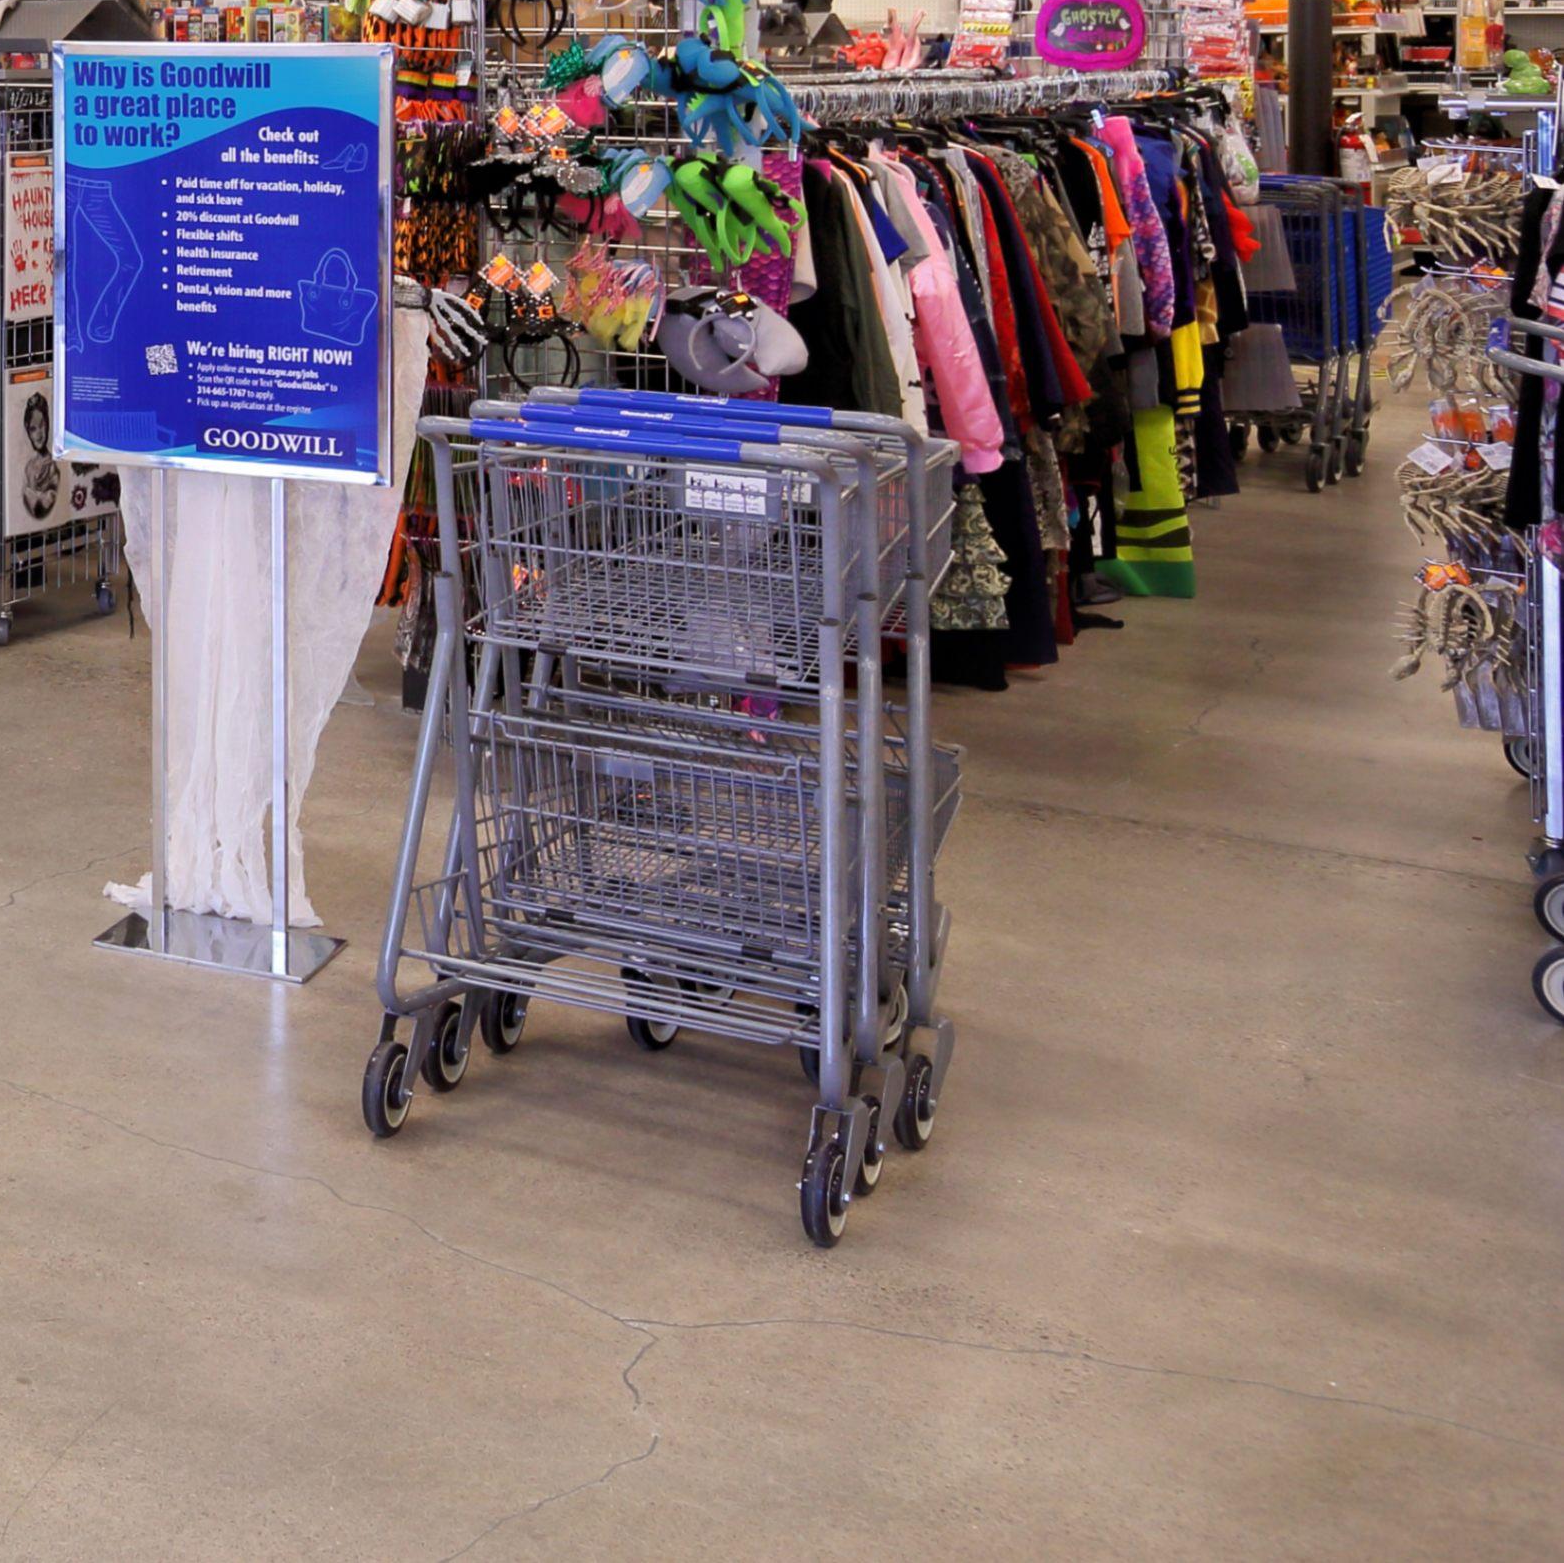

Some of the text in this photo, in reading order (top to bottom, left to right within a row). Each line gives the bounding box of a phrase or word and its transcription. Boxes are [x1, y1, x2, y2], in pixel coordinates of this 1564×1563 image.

[1060, 7, 1122, 26] GHOSTLY
[73, 61, 271, 89] Why is Goodwill
[74, 93, 237, 120] a great place
[74, 122, 181, 147] to work?
[258, 126, 319, 143] Check out
[221, 147, 319, 165] all the benefits:
[176, 176, 345, 196] Paid time off for vacation, holiday,
[12, 186, 53, 211] HAUNT
[176, 192, 243, 206] and sick leave
[176, 210, 299, 226] 20% discount at Goodwill
[176, 228, 244, 242] Flexible shifts
[176, 246, 259, 261] Health insurance
[176, 264, 233, 278] Retirement
[176, 282, 292, 299] Dental, vision and more
[176, 299, 217, 313] benefits
[186, 340, 353, 366] We're hiring RIGHT NOW!
[197, 362, 216, 374] Apply
[216, 364, 236, 374] online
[197, 374, 212, 383] Scan
[213, 375, 224, 384] the
[224, 376, 234, 385] QR
[235, 377, 250, 386] code
[330, 384, 338, 392] to
[197, 397, 210, 407] Pick
[211, 400, 220, 409] up
[230, 401, 265, 411] application
[273, 404, 285, 412] the
[203, 427, 344, 457] GOODWILL
